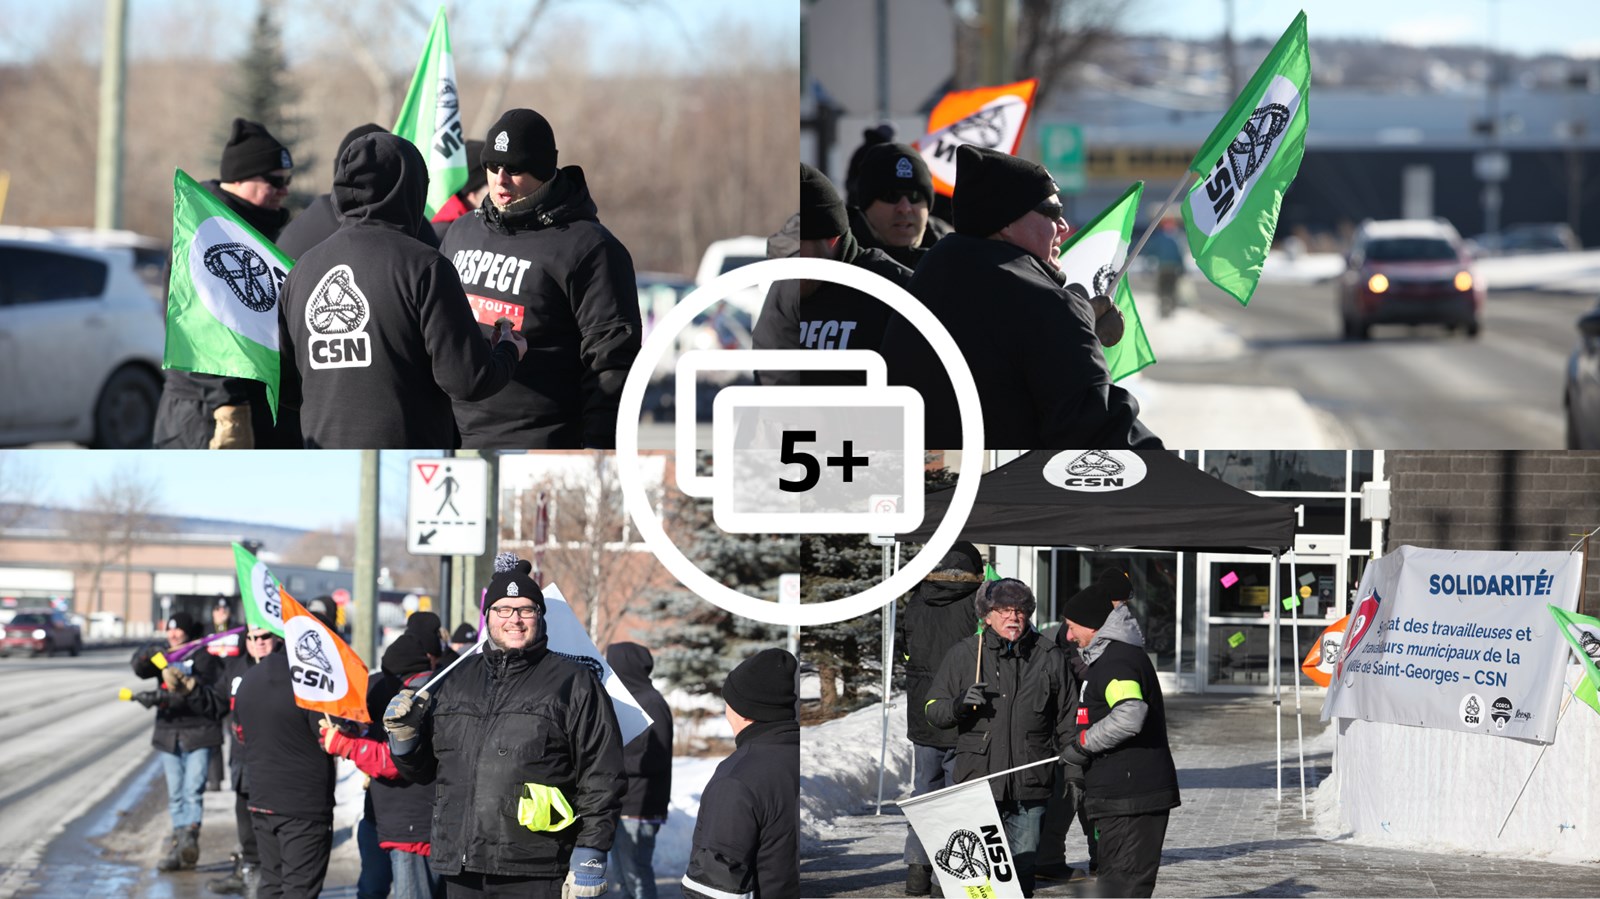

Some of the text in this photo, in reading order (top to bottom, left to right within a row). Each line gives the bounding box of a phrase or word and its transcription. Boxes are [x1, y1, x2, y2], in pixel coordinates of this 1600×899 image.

[1205, 155, 1235, 225] SN
[311, 338, 366, 364] CSN
[1064, 478, 1124, 487] CSN
[1429, 568, 1555, 596] SOLIDARITÉ!
[265, 601, 282, 619] CS
[1403, 618, 1429, 634] des
[1432, 621, 1512, 640] travailleuses
[1516, 626, 1532, 641] et
[1406, 643, 1481, 662] municipaux
[1483, 647, 1502, 662] de
[1506, 648, 1520, 664] la
[291, 666, 335, 694] CSN
[1361, 661, 1372, 674] de
[1372, 661, 1460, 685] Saint-Georges
[1474, 670, 1508, 687] CSN
[1464, 715, 1480, 724] CSN
[980, 824, 1012, 882] CSN
